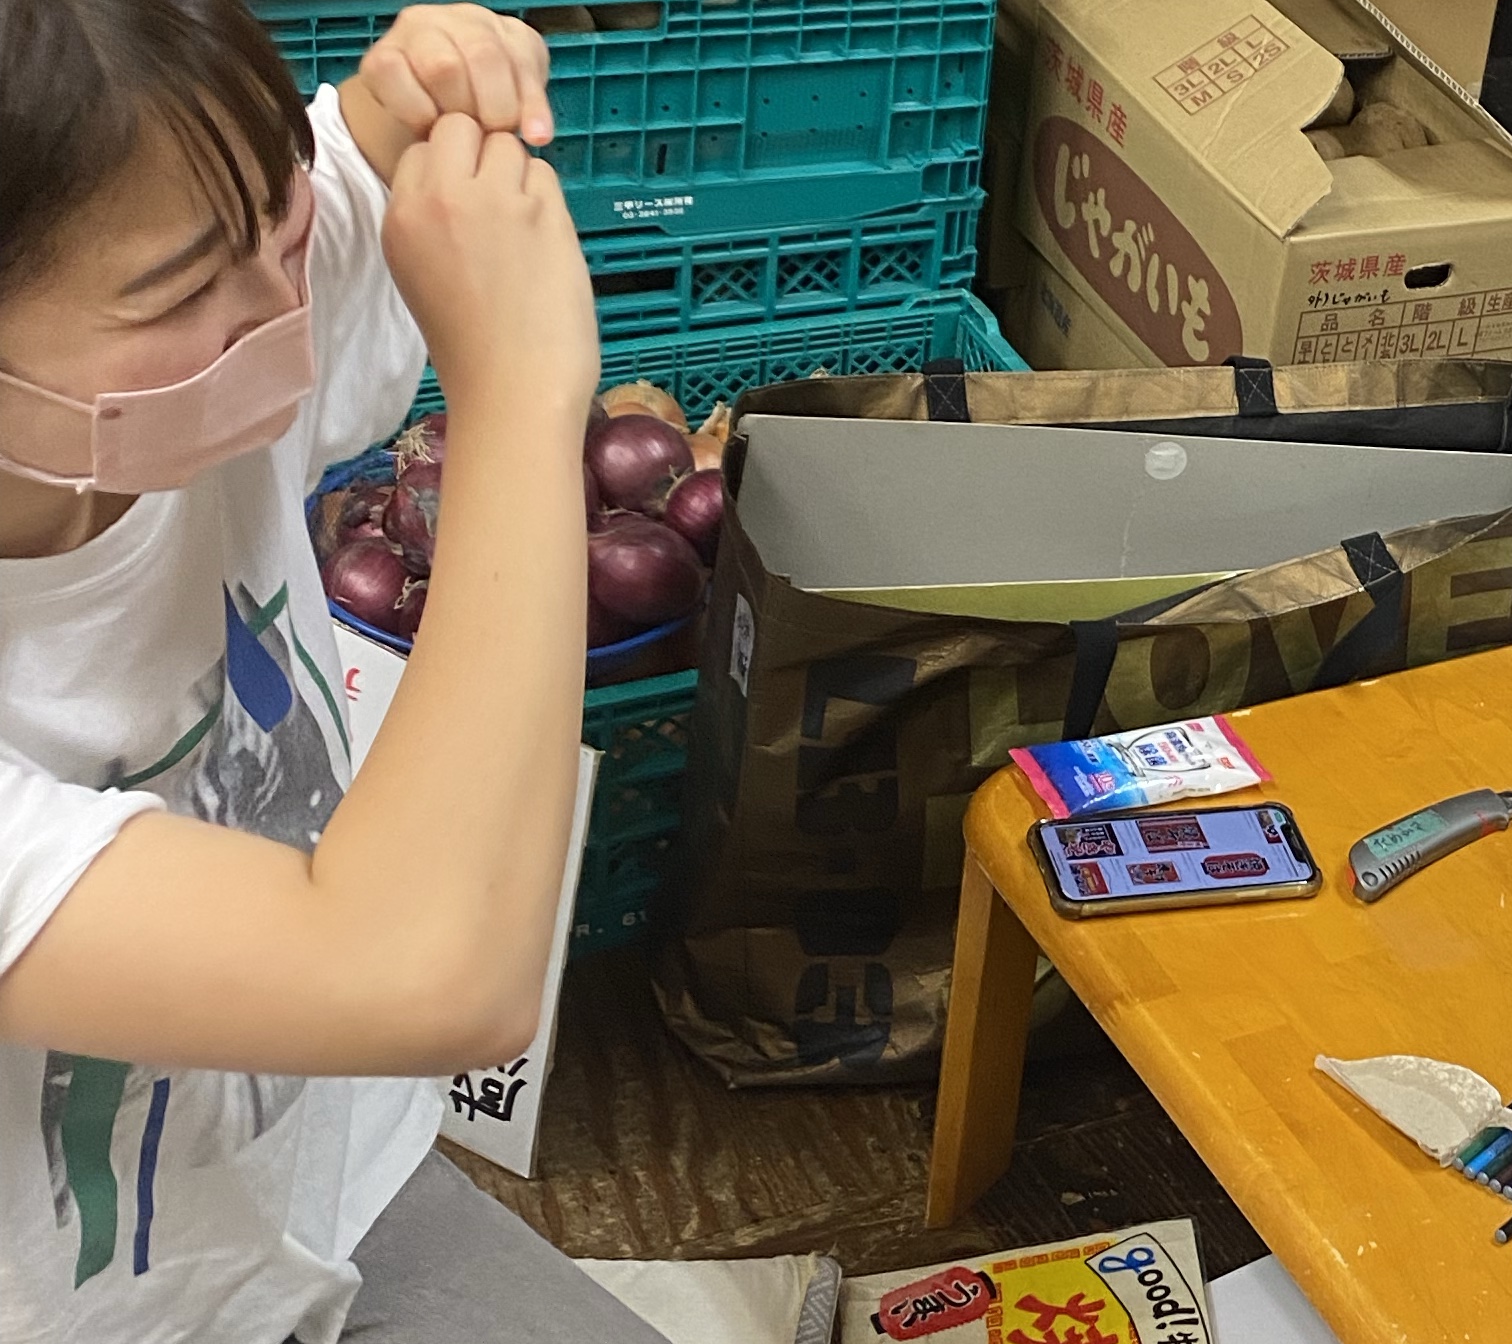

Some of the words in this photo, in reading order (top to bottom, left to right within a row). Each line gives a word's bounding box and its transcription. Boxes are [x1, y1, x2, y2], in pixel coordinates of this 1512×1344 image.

[1174, 76, 1204, 96] 3L
[1207, 56, 1237, 76] 2L
[1190, 86, 1213, 106] M
[1226, 69, 1244, 83] S
[1054, 142, 1211, 362] じゃがいも
[1308, 253, 1407, 285] 茨城県産
[1399, 333, 1421, 354] 3L
[1426, 329, 1447, 351] 2L
[1456, 327, 1468, 347] L
[1099, 1245, 1200, 1332] good!
